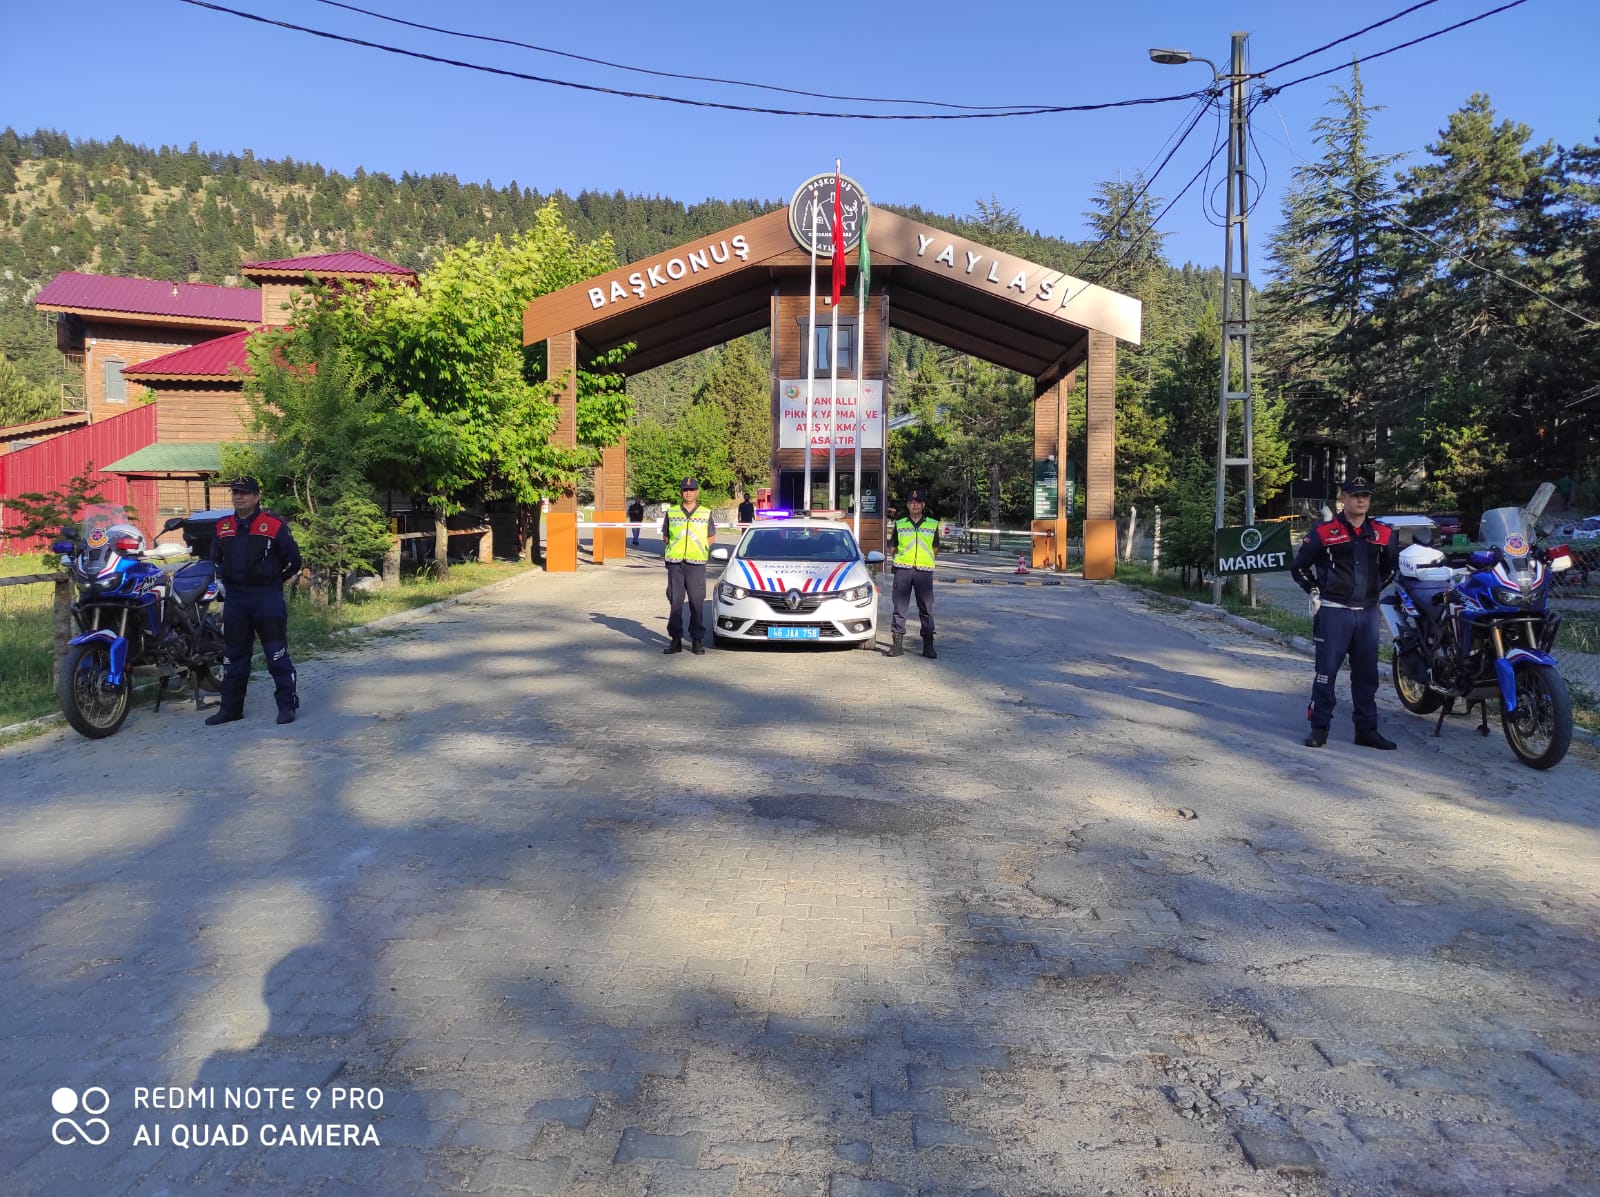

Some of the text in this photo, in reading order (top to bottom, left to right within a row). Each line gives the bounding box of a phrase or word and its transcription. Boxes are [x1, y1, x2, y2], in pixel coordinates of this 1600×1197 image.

[808, 178, 852, 192] BAŞKOUŞ
[587, 233, 1069, 310] BAŞKONUŞ YAYLASI
[806, 397, 857, 406] ANALLI
[784, 408, 818, 418] PİKNK
[866, 410, 878, 418] VE
[824, 424, 866, 432] YKMAK
[1219, 552, 1286, 572] MARKET
[773, 628, 782, 637] 46
